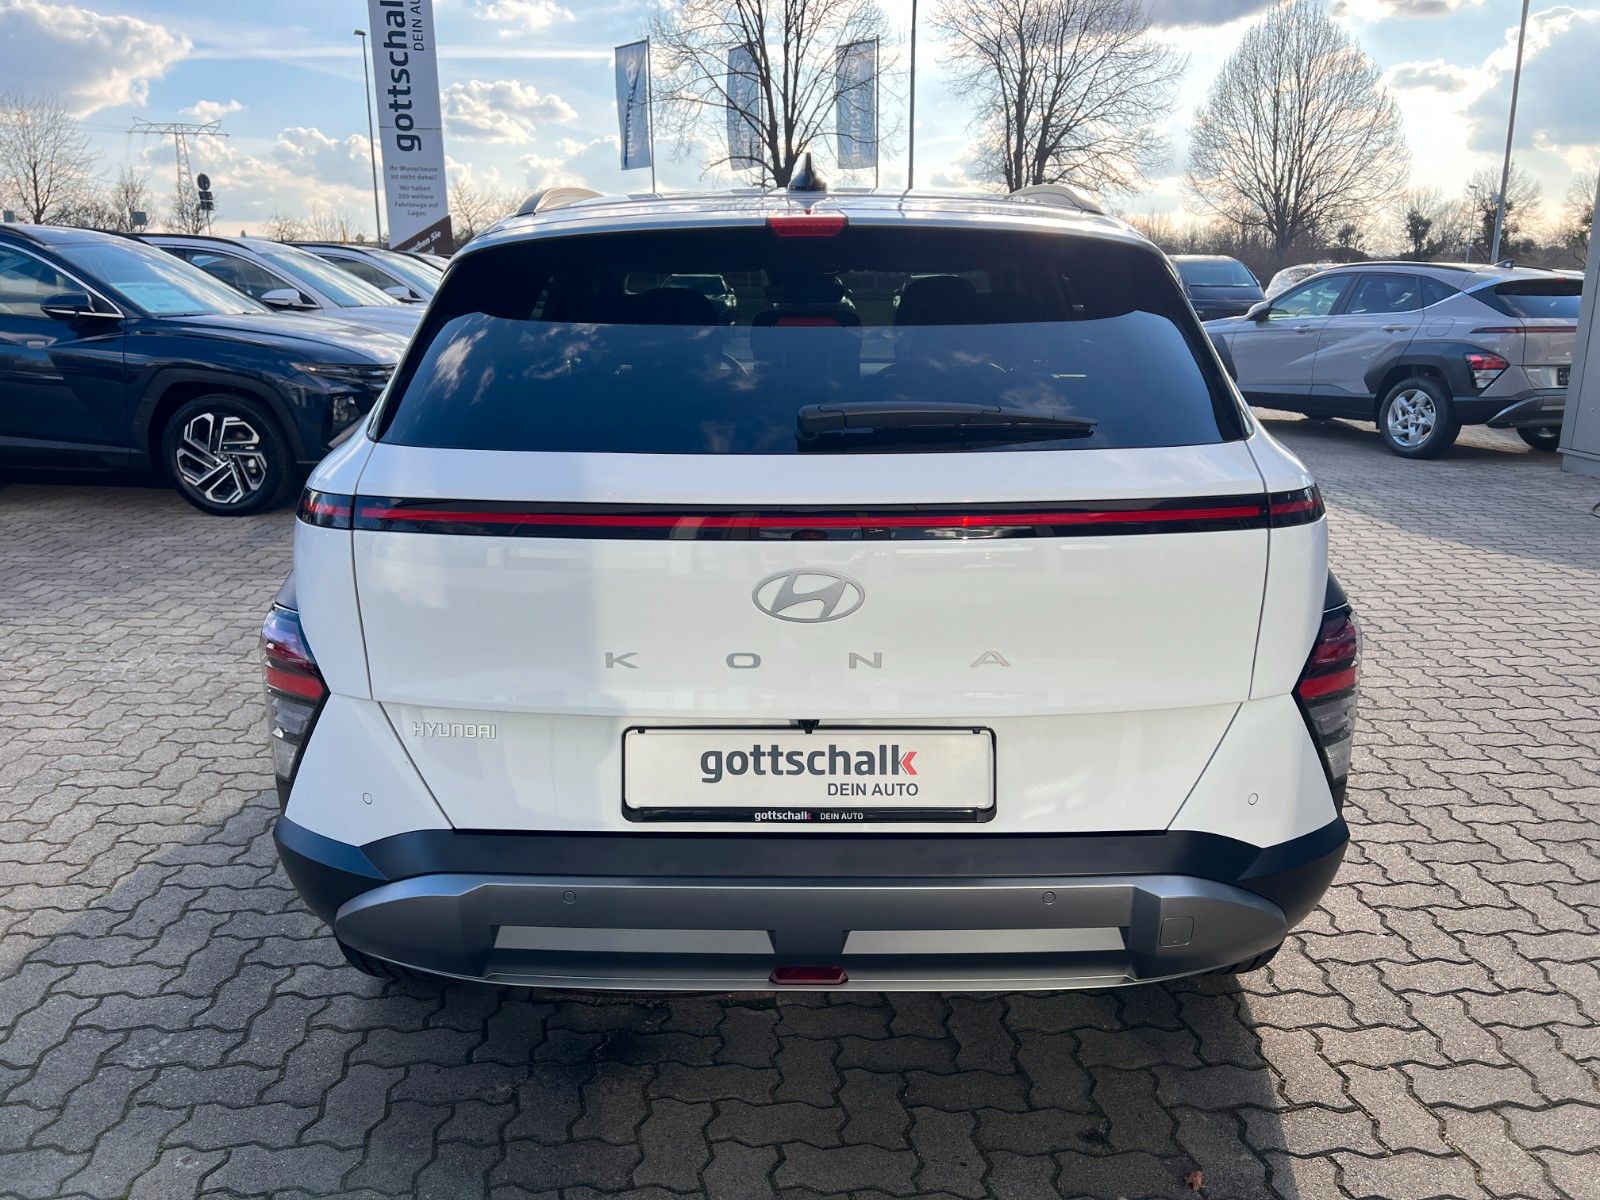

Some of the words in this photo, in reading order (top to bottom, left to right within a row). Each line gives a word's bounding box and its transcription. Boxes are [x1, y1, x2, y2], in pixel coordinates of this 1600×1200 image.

[411, 18, 425, 51] DEIN
[412, 721, 497, 739] HYUNDAI
[700, 744, 918, 783] gottschalk
[827, 783, 867, 796] DEIN
[871, 783, 919, 796] AUTO
[754, 810, 811, 822] gottschalk
[820, 812, 839, 820] DEIN
[841, 812, 864, 820] AUTO
